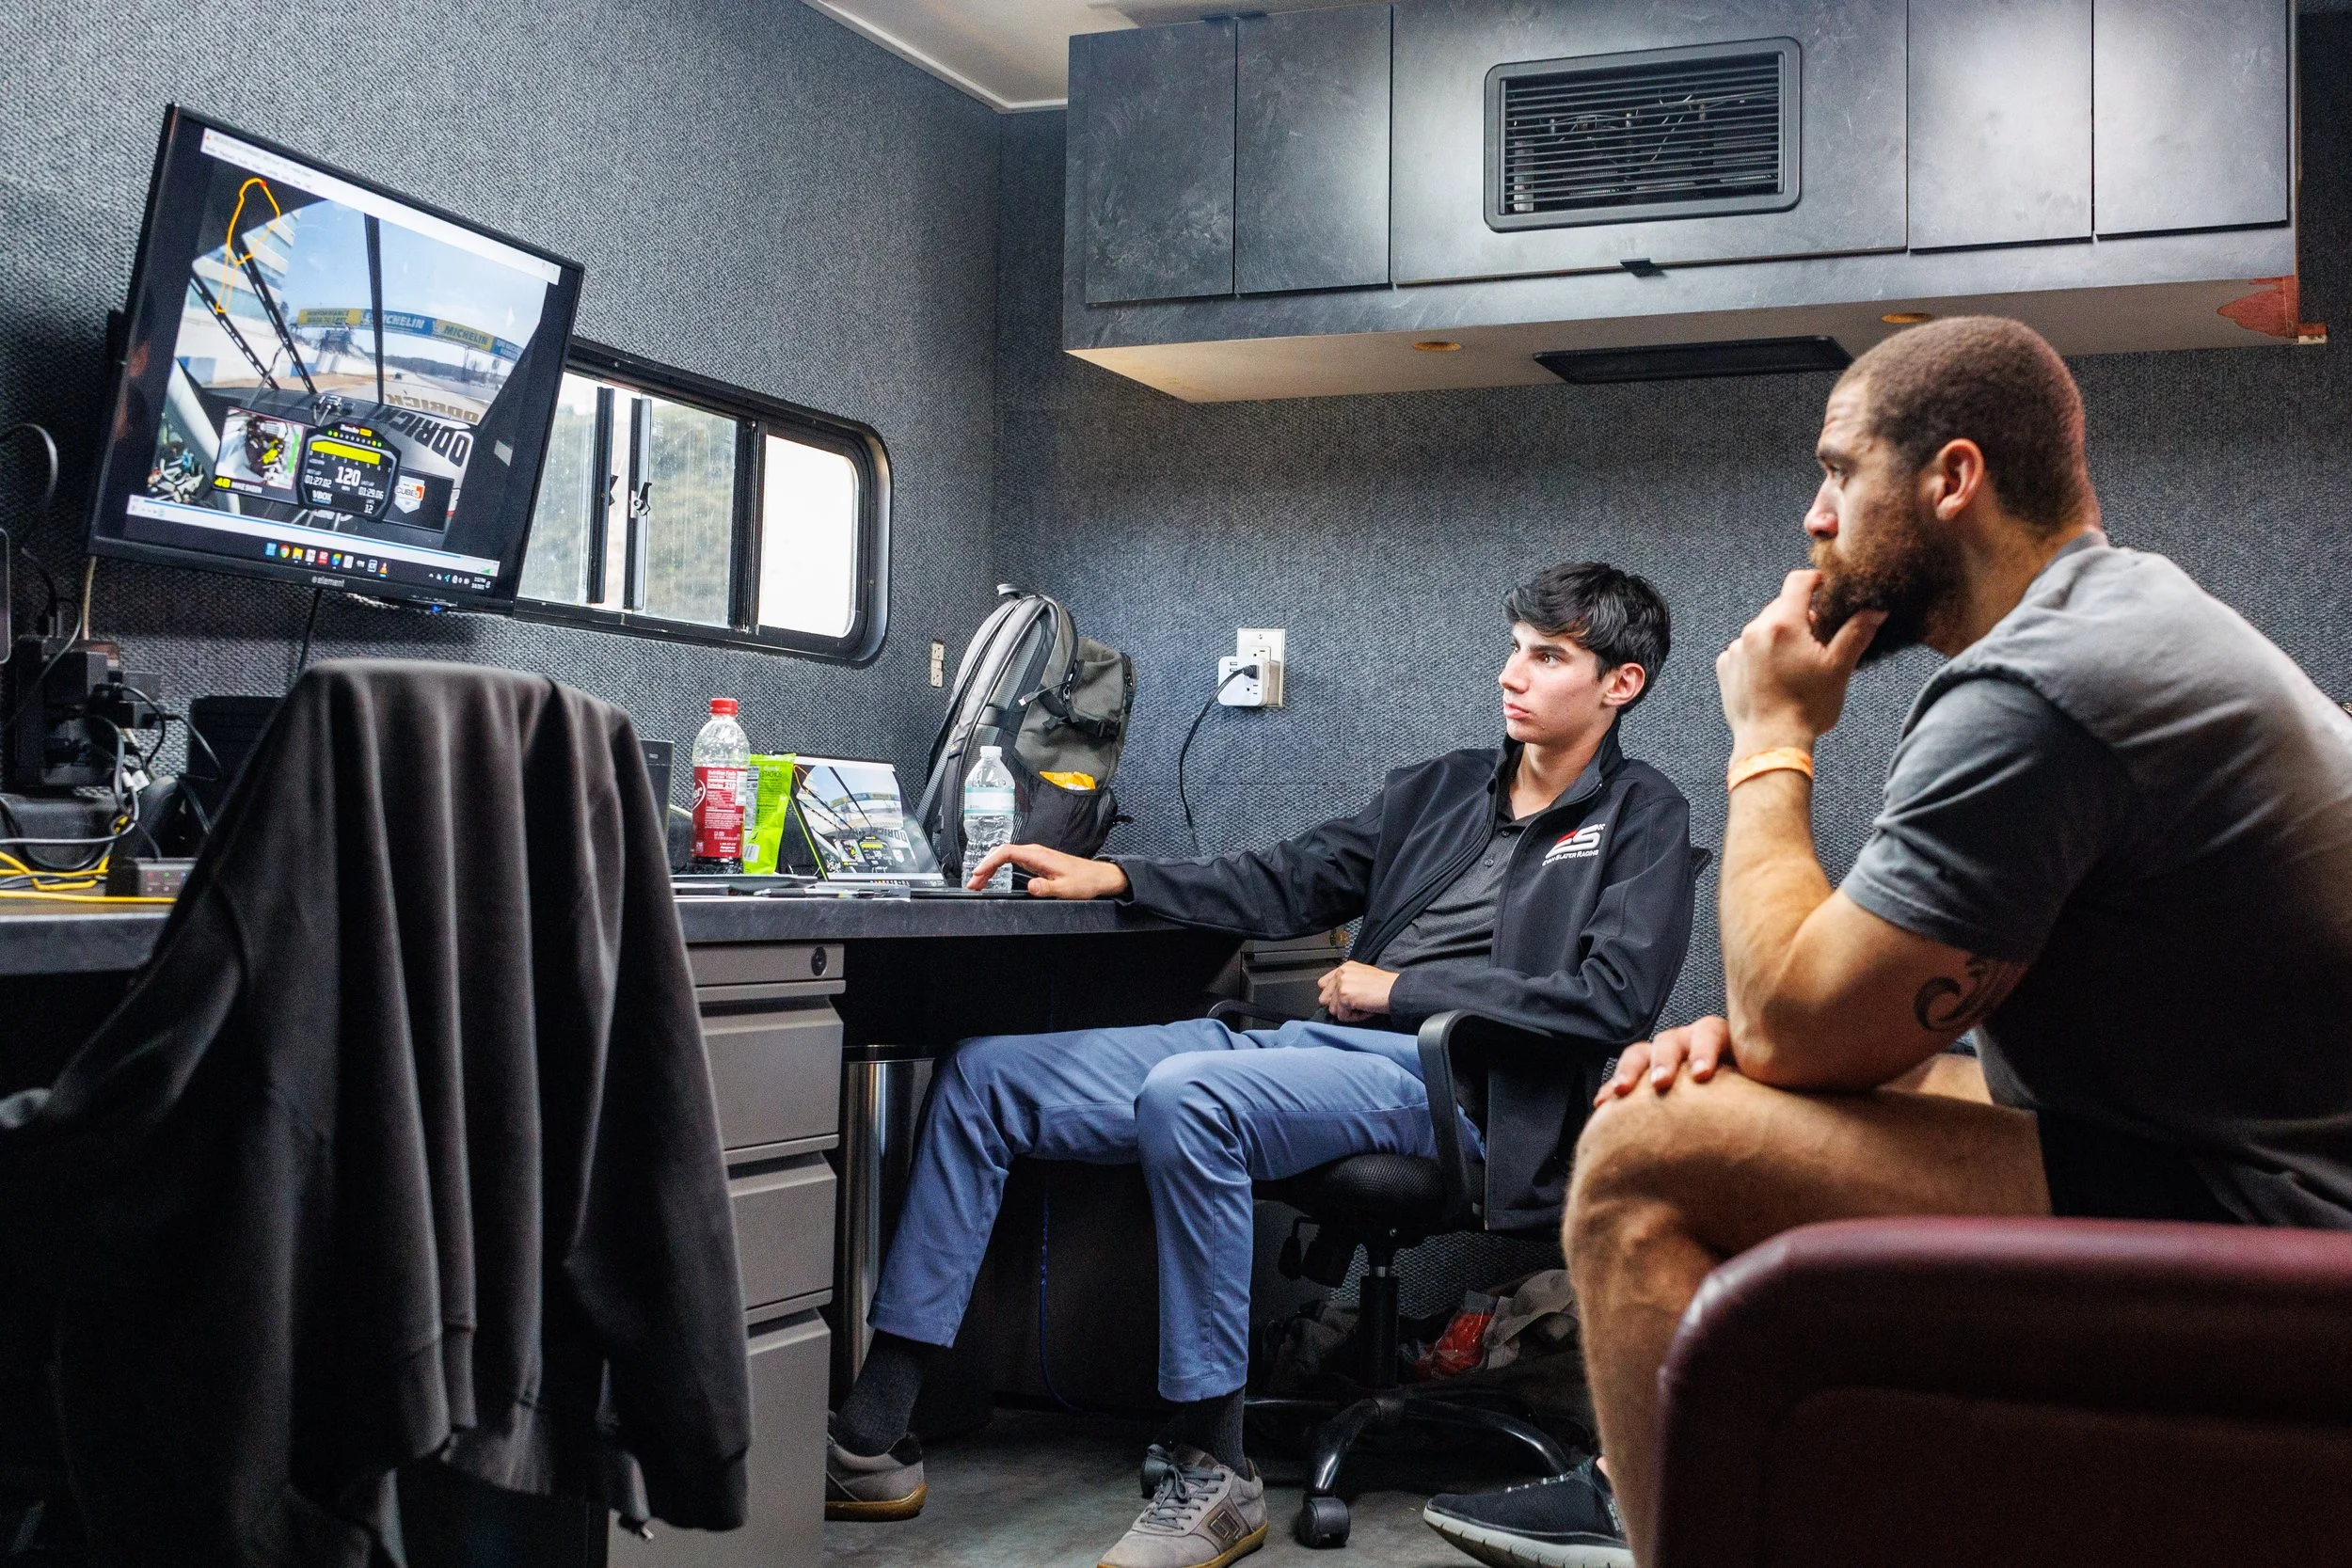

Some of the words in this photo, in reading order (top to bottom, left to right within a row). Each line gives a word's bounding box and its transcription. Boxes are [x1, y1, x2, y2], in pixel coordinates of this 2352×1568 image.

[381, 313, 426, 329] ICHELIN
[443, 325, 488, 345] MICHELIN
[335, 466, 361, 487] 120
[312, 489, 333, 501] VBOX
[364, 504, 374, 515] 12
[1577, 849, 1599, 858] RACING
